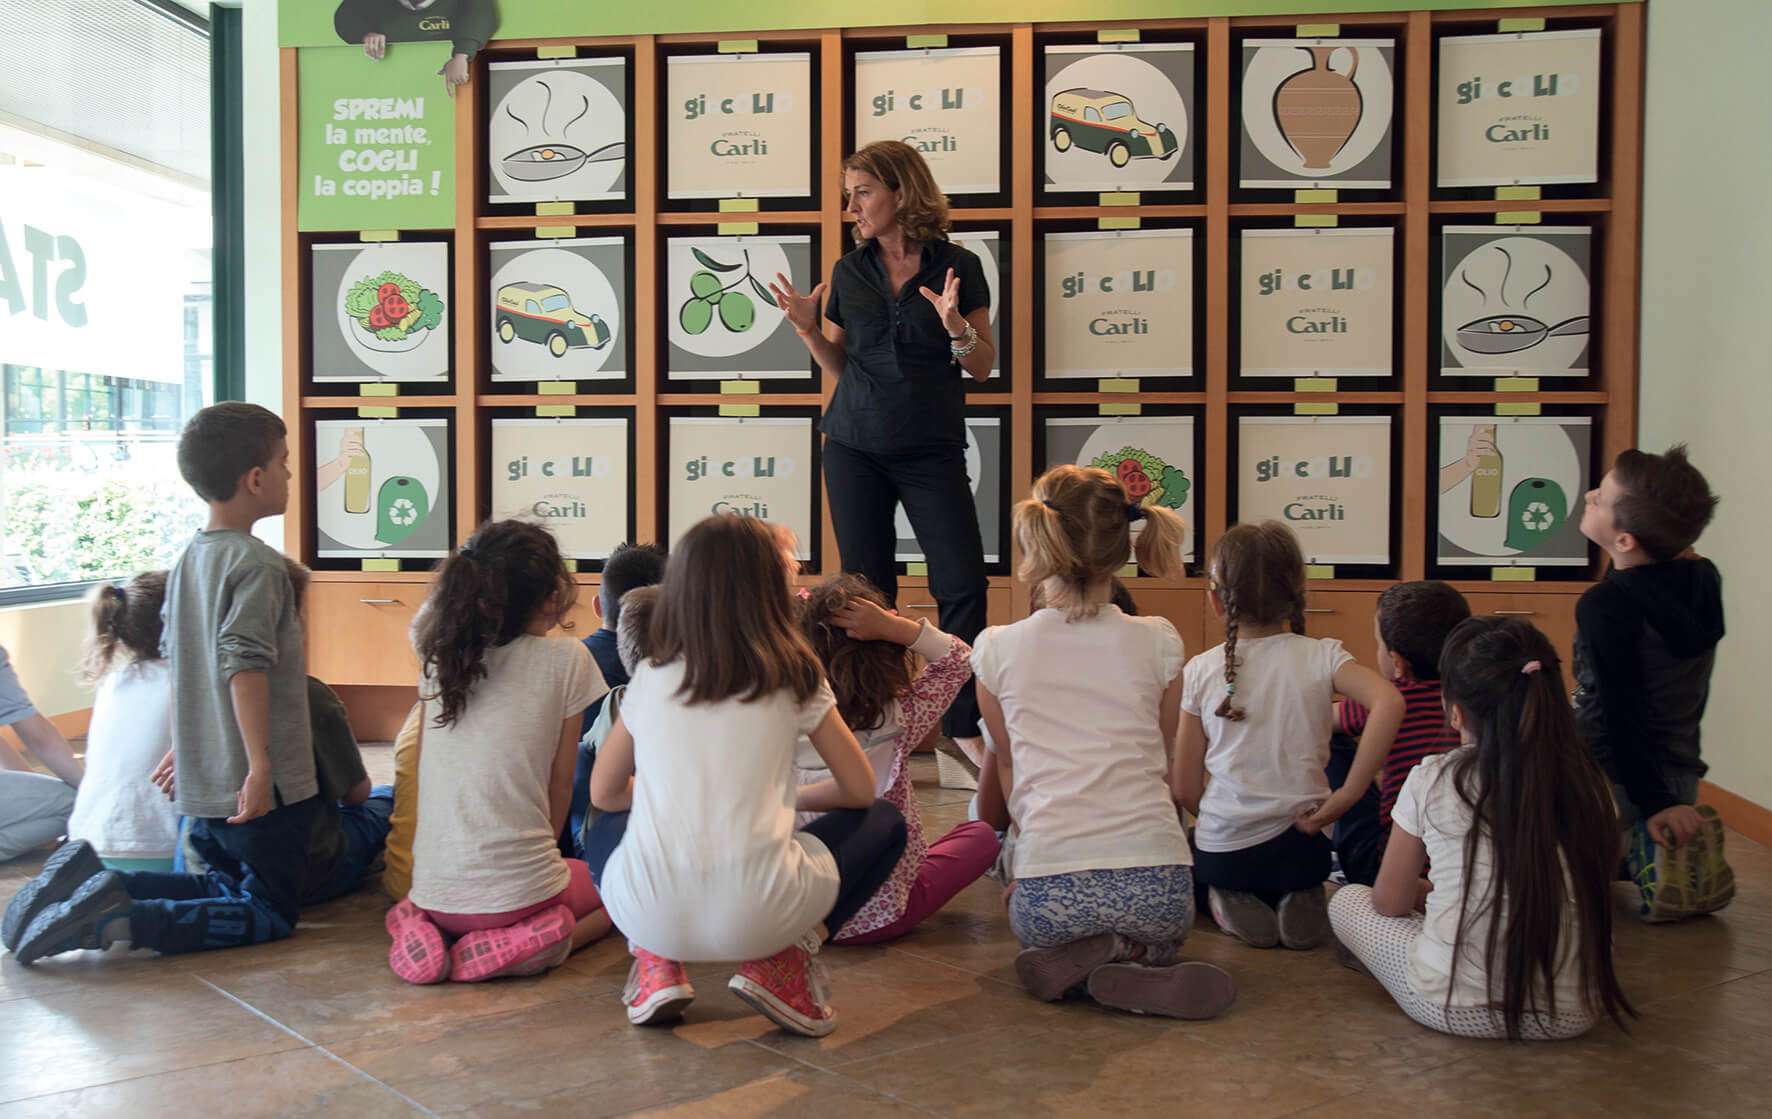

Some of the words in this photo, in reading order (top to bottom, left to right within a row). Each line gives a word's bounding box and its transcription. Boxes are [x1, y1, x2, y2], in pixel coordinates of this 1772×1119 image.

[419, 19, 450, 30] Carli
[333, 97, 424, 120] SPREMI
[325, 123, 347, 144] la
[1485, 123, 1550, 143] Carli
[710, 139, 768, 157] Carli
[339, 149, 418, 172] COGLI
[314, 175, 336, 196] la
[1088, 318, 1149, 336] Carli
[1286, 316, 1348, 334] Carli
[532, 501, 586, 518] Carli
[1283, 503, 1344, 521] Carli
